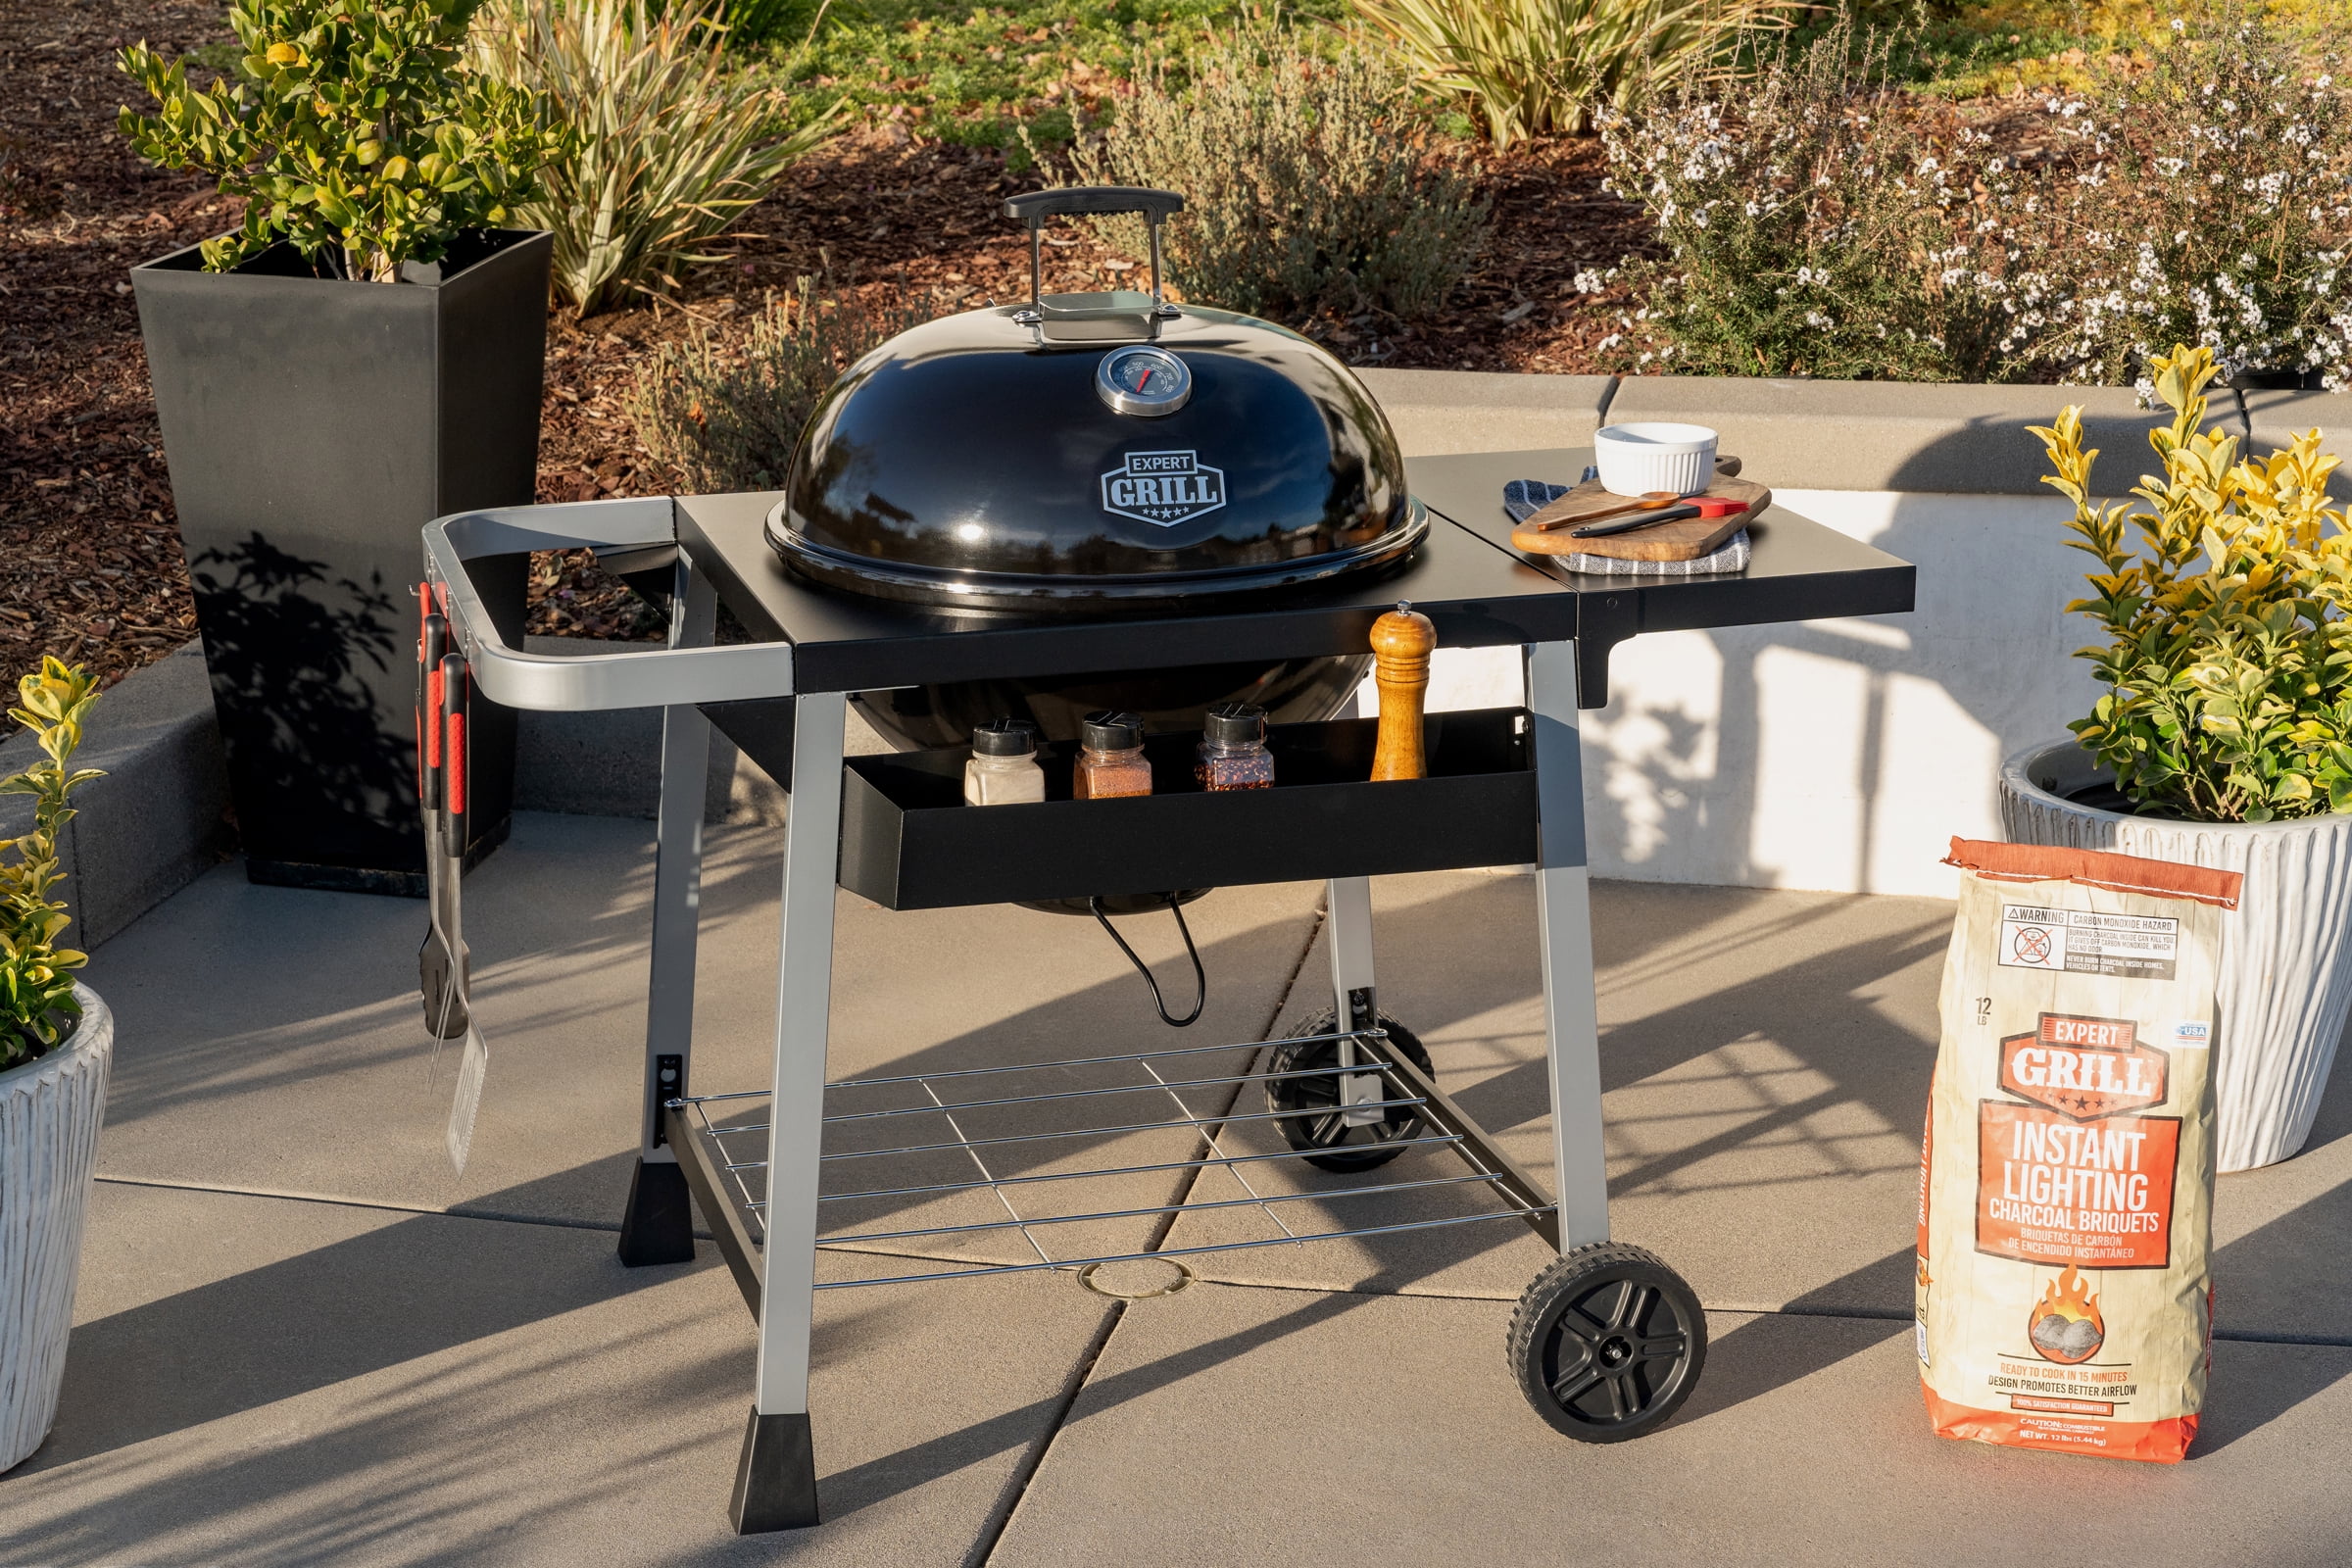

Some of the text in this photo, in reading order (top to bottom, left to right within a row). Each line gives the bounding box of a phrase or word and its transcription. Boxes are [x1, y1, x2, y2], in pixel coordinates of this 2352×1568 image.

[1132, 456, 1191, 470] EXPERT
[1110, 475, 1218, 508] GRILL
[2019, 907, 2065, 923] WARNING
[2074, 914, 2173, 931] CARBON MONOXIDE HAZARD
[2069, 928, 2092, 938] BURNING
[2093, 930, 2118, 940] CHARCOAL
[2119, 933, 2136, 942] INSIDE
[2137, 934, 2149, 943] CAN
[2101, 939, 2121, 948] CARBON
[1976, 997, 1991, 1015] 12
[1977, 1016, 1987, 1026] LB
[2055, 1020, 2120, 1046] EXPERT
[2184, 1026, 2205, 1036] USA
[2011, 1047, 2151, 1097] GRILL
[2013, 1120, 2146, 1171] INSTANT
[2003, 1160, 2149, 1211] LIGHTING
[1989, 1198, 2160, 1235] CHARCOAL BRIQUETS
[2021, 1227, 2123, 1247] BRIQUETAS DE CARBÓN
[2008, 1237, 2134, 1258] DE ENCENDIDO INSTANTÁNEO
[2000, 1362, 2128, 1383] READY TO COOK IN 15 MINUTES
[1988, 1375, 2137, 1397] DESIGN PROMOTES BETTER AIRFLOW
[2017, 1398, 2108, 1412] 100% SATISFACTION GUARANTEED
[2020, 1418, 2062, 1428] CAUTION:
[2063, 1423, 2105, 1432] COMBUSTIBLE
[2020, 1430, 2034, 1439] NET
[2093, 1438, 2106, 1446] kg)
